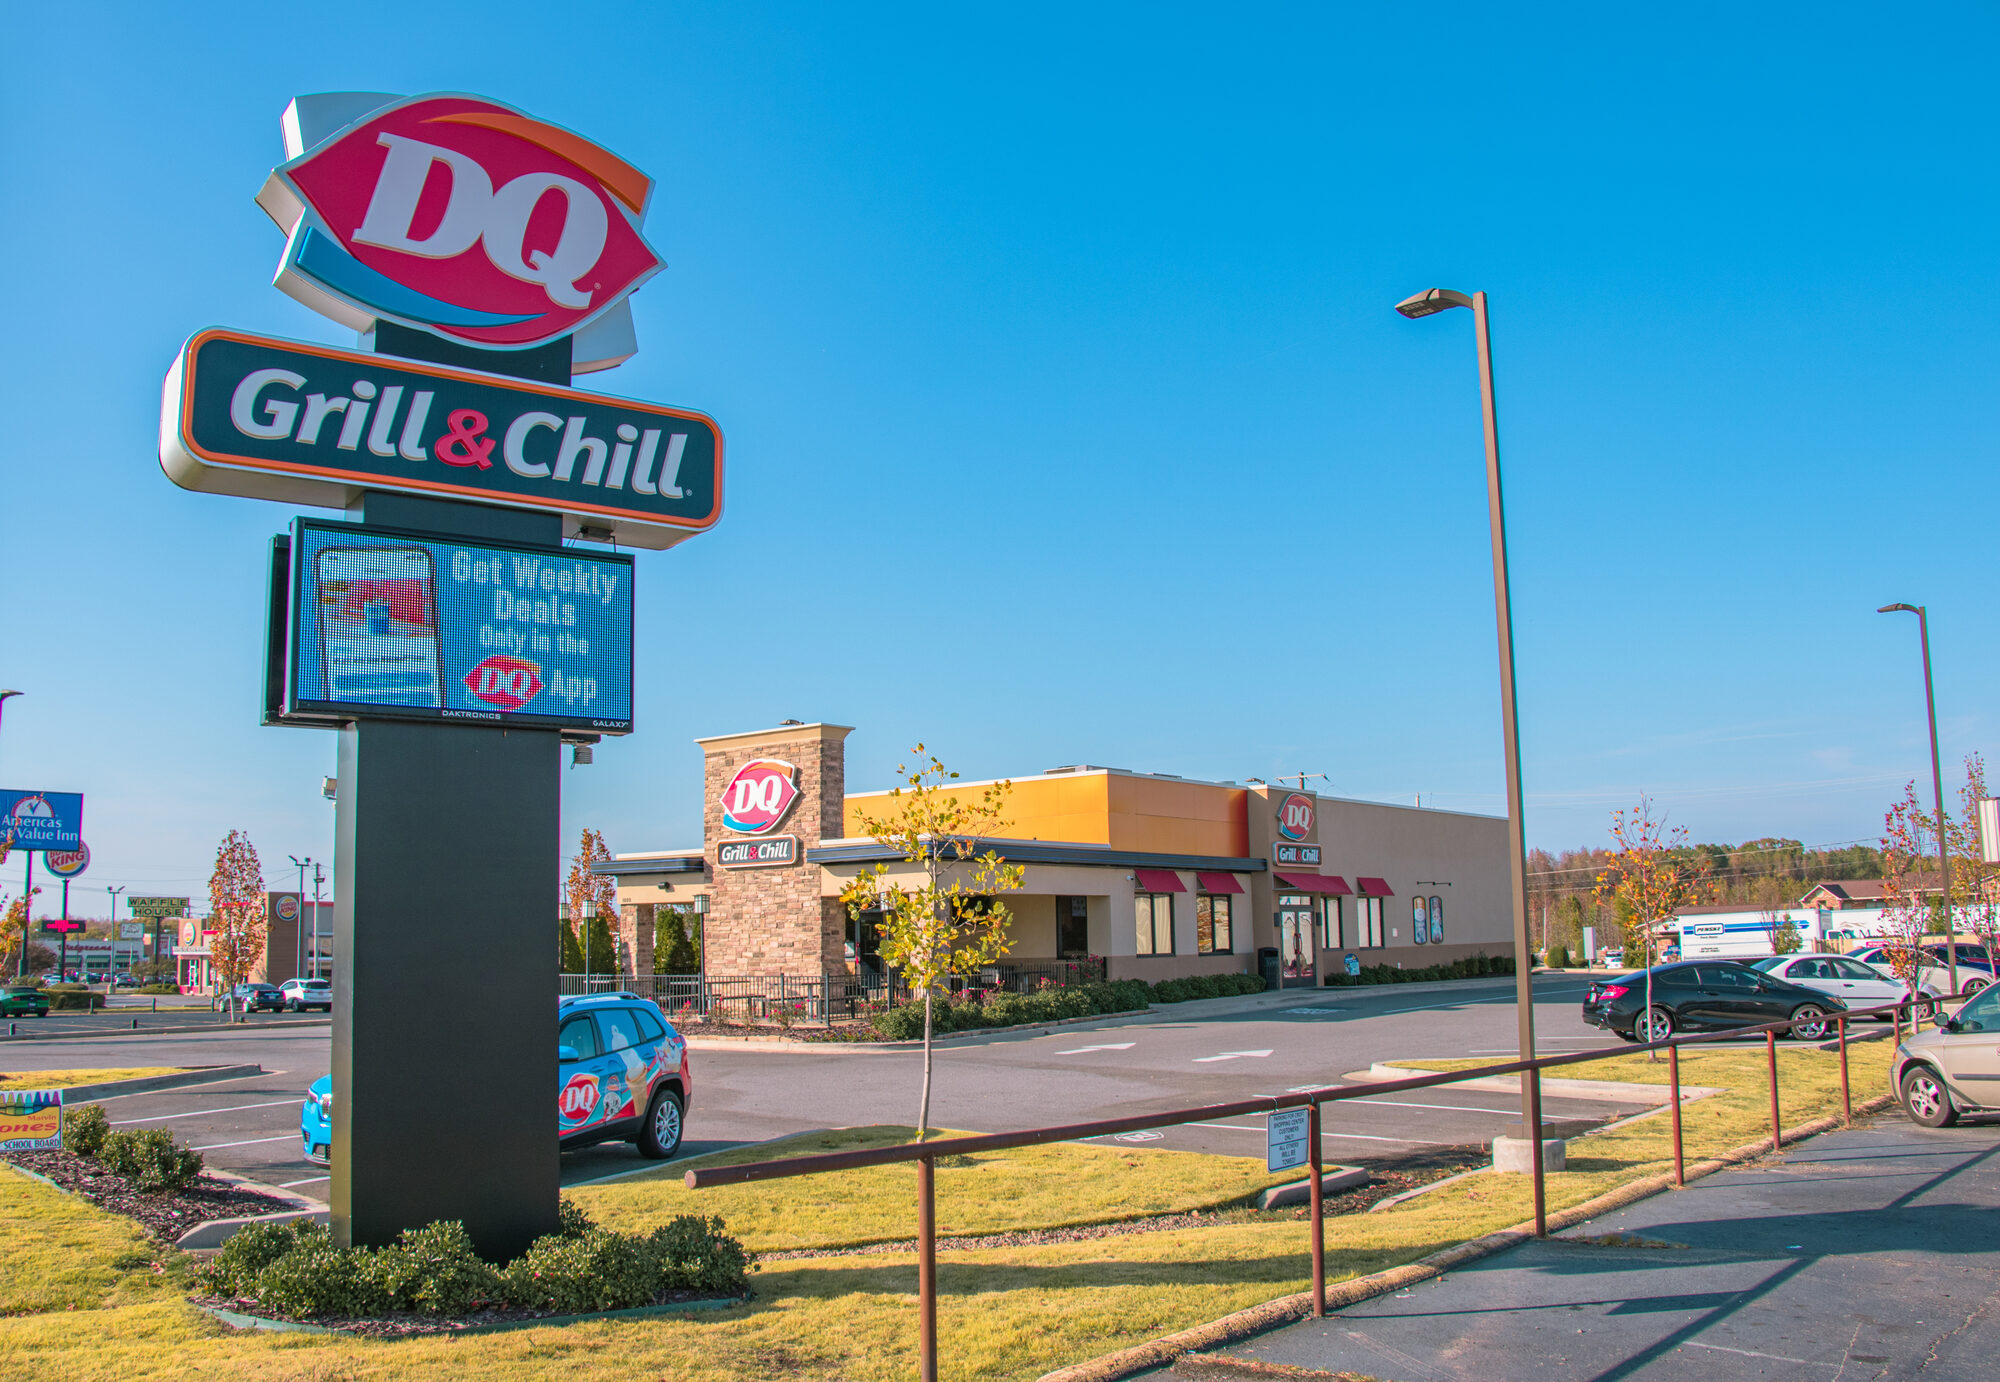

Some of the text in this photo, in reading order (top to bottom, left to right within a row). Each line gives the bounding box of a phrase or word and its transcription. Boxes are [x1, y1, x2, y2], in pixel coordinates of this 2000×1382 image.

[351, 132, 608, 309] DQ
[231, 369, 688, 499] Grill & Chill
[452, 550, 617, 603] Get Weekly
[495, 589, 576, 626] Deals
[480, 624, 589, 655] Only in the
[479, 666, 596, 706] DQ App
[442, 710, 501, 720] DAKTRONICS
[592, 720, 627, 728] GALAXY
[732, 775, 782, 815] DQ
[1287, 805, 1309, 830] DQ
[17, 828, 54, 840] Value
[57, 829, 79, 841] Inn
[50, 850, 85, 869] KING
[722, 845, 748, 861] Grill
[758, 841, 789, 860] Chill
[1279, 847, 1296, 861] Grill
[1302, 848, 1319, 862] Chill
[565, 1084, 594, 1113] DQ
[0, 1123, 56, 1132] ones
[3, 1139, 59, 1150] SCHOOL BOARD
